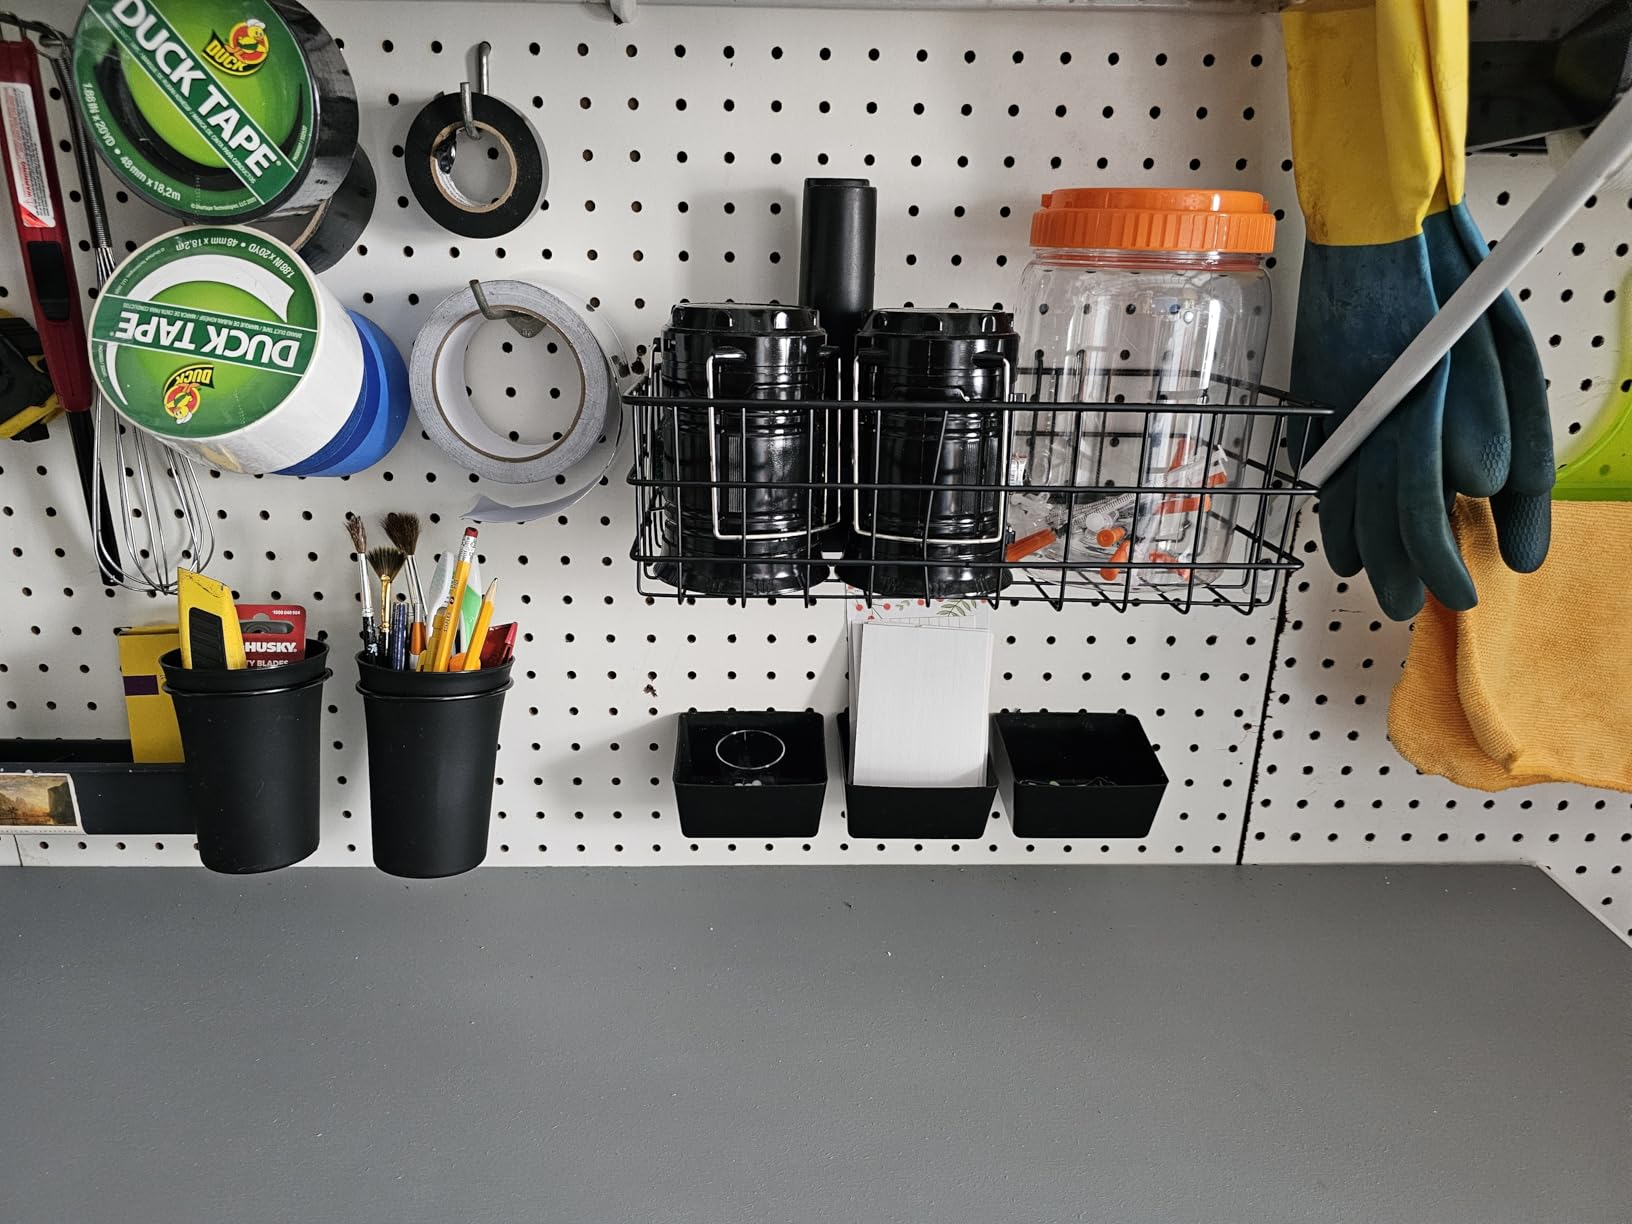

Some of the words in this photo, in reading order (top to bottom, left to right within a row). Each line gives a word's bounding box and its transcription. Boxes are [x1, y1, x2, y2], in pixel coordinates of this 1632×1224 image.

[206, 39, 248, 72] DUCK
[112, 0, 206, 97] DUCK
[198, 84, 272, 177] TAPE
[115, 311, 195, 350] TAPE
[201, 325, 299, 367] DUCK
[175, 366, 213, 386] DUCK
[245, 642, 296, 652] HUSKY
